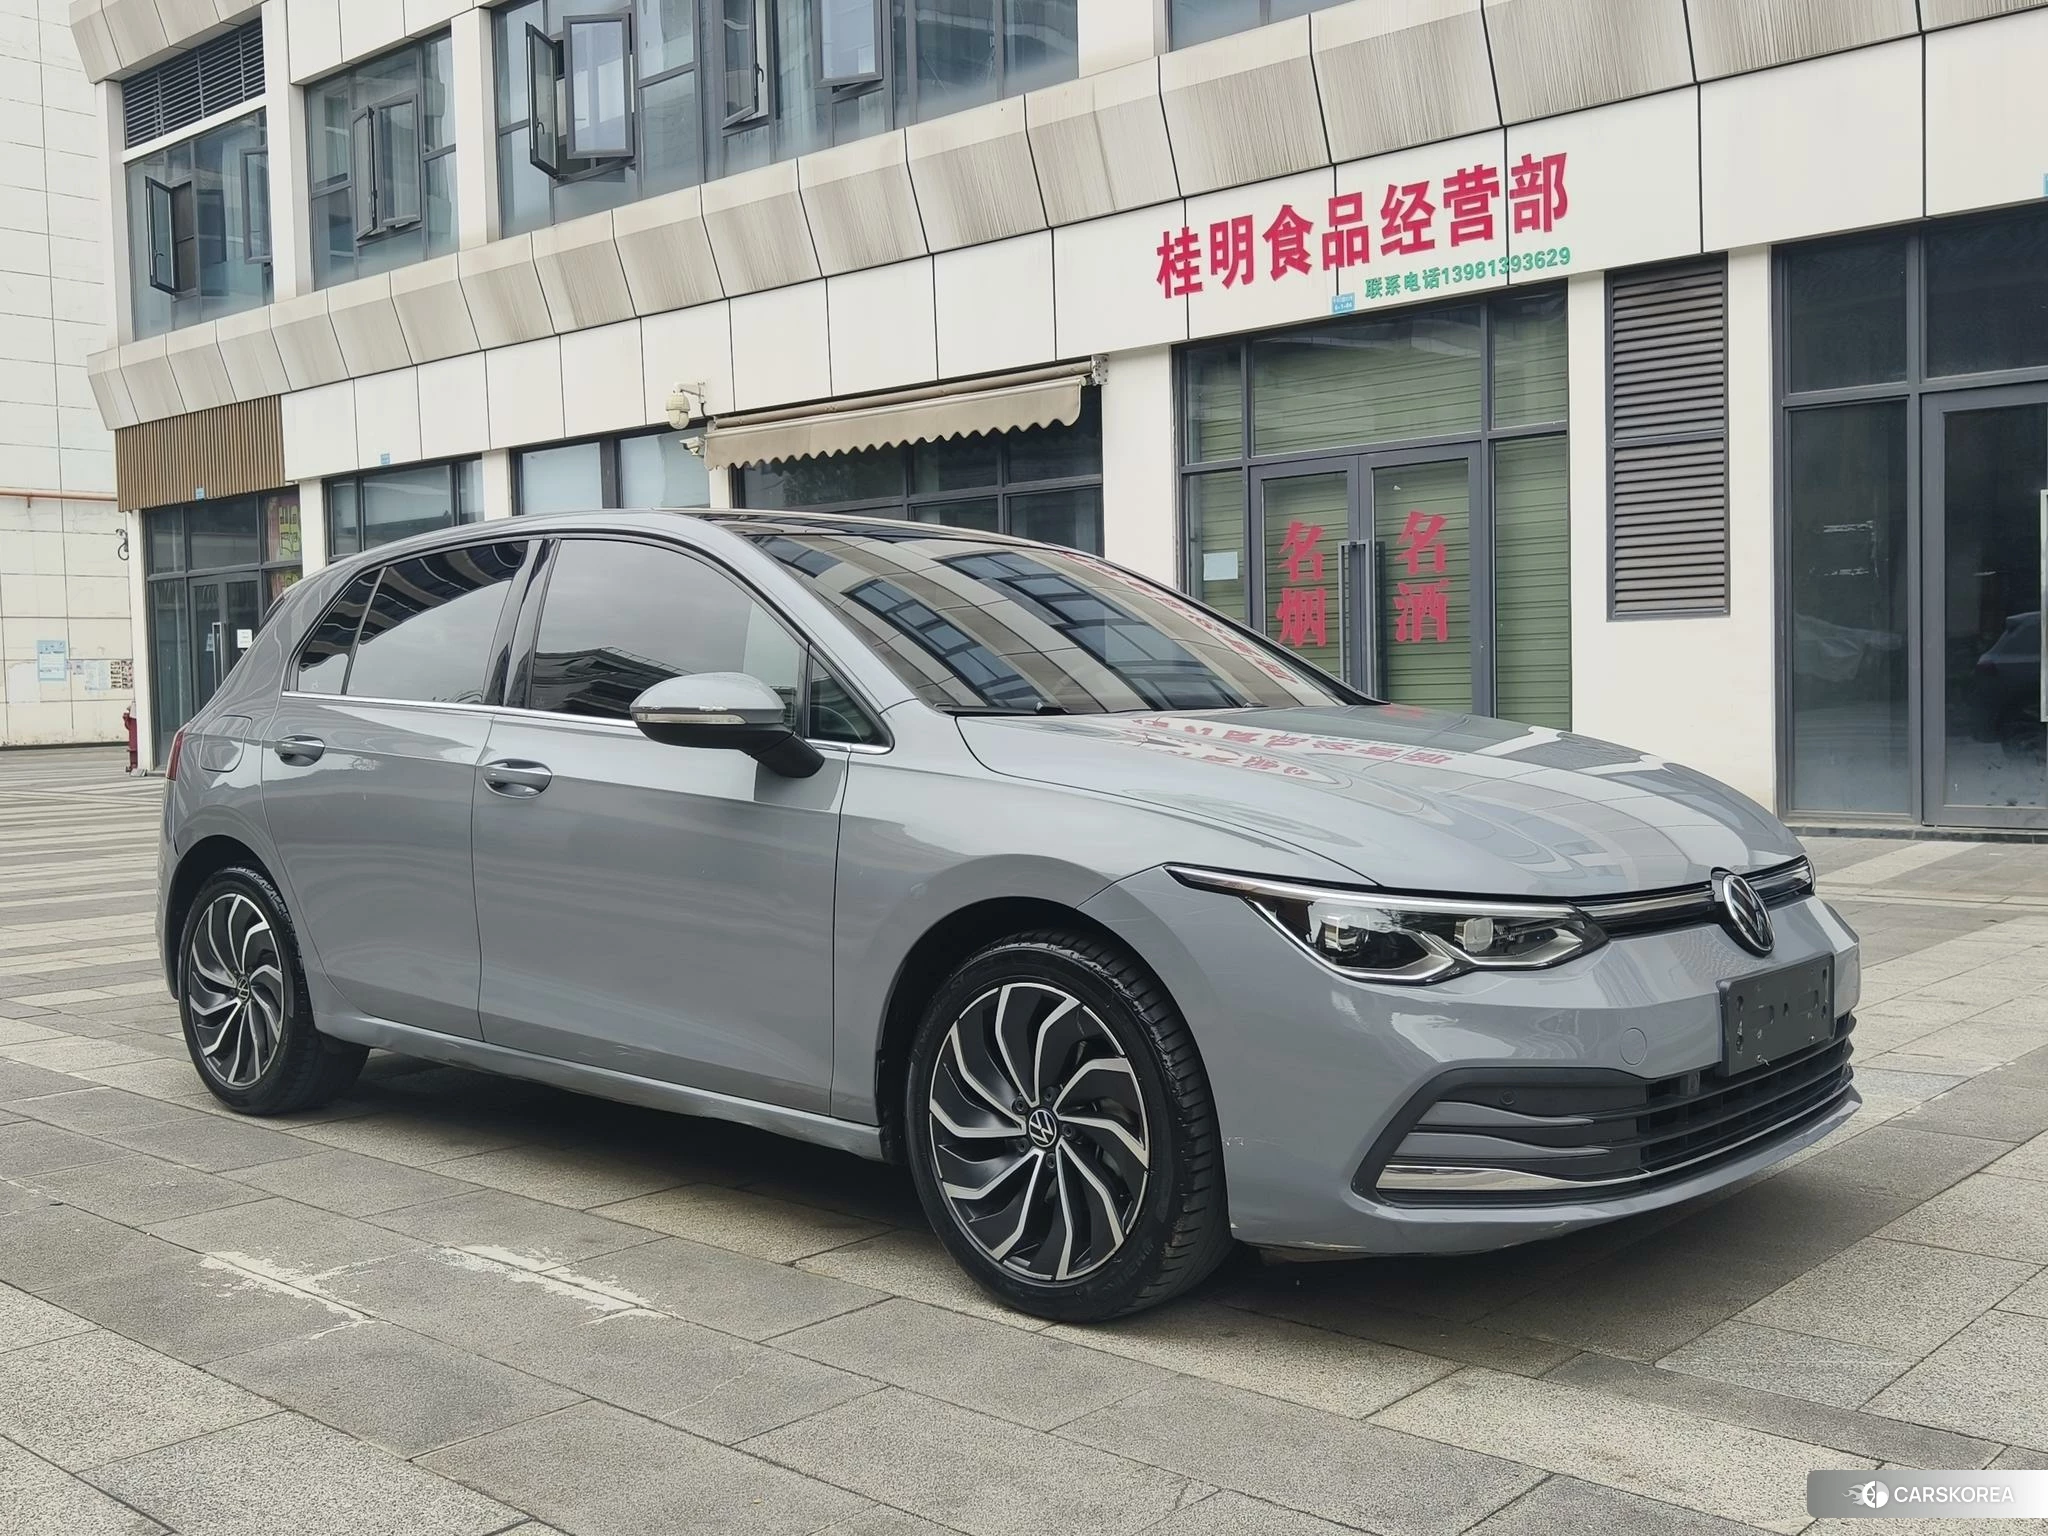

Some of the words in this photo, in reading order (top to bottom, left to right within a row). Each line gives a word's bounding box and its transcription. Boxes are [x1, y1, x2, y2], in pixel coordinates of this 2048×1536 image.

[1156, 153, 1568, 299] 桂明食品经营部
[1276, 521, 1328, 648] 名烟
[1393, 510, 1449, 643] 名酒
